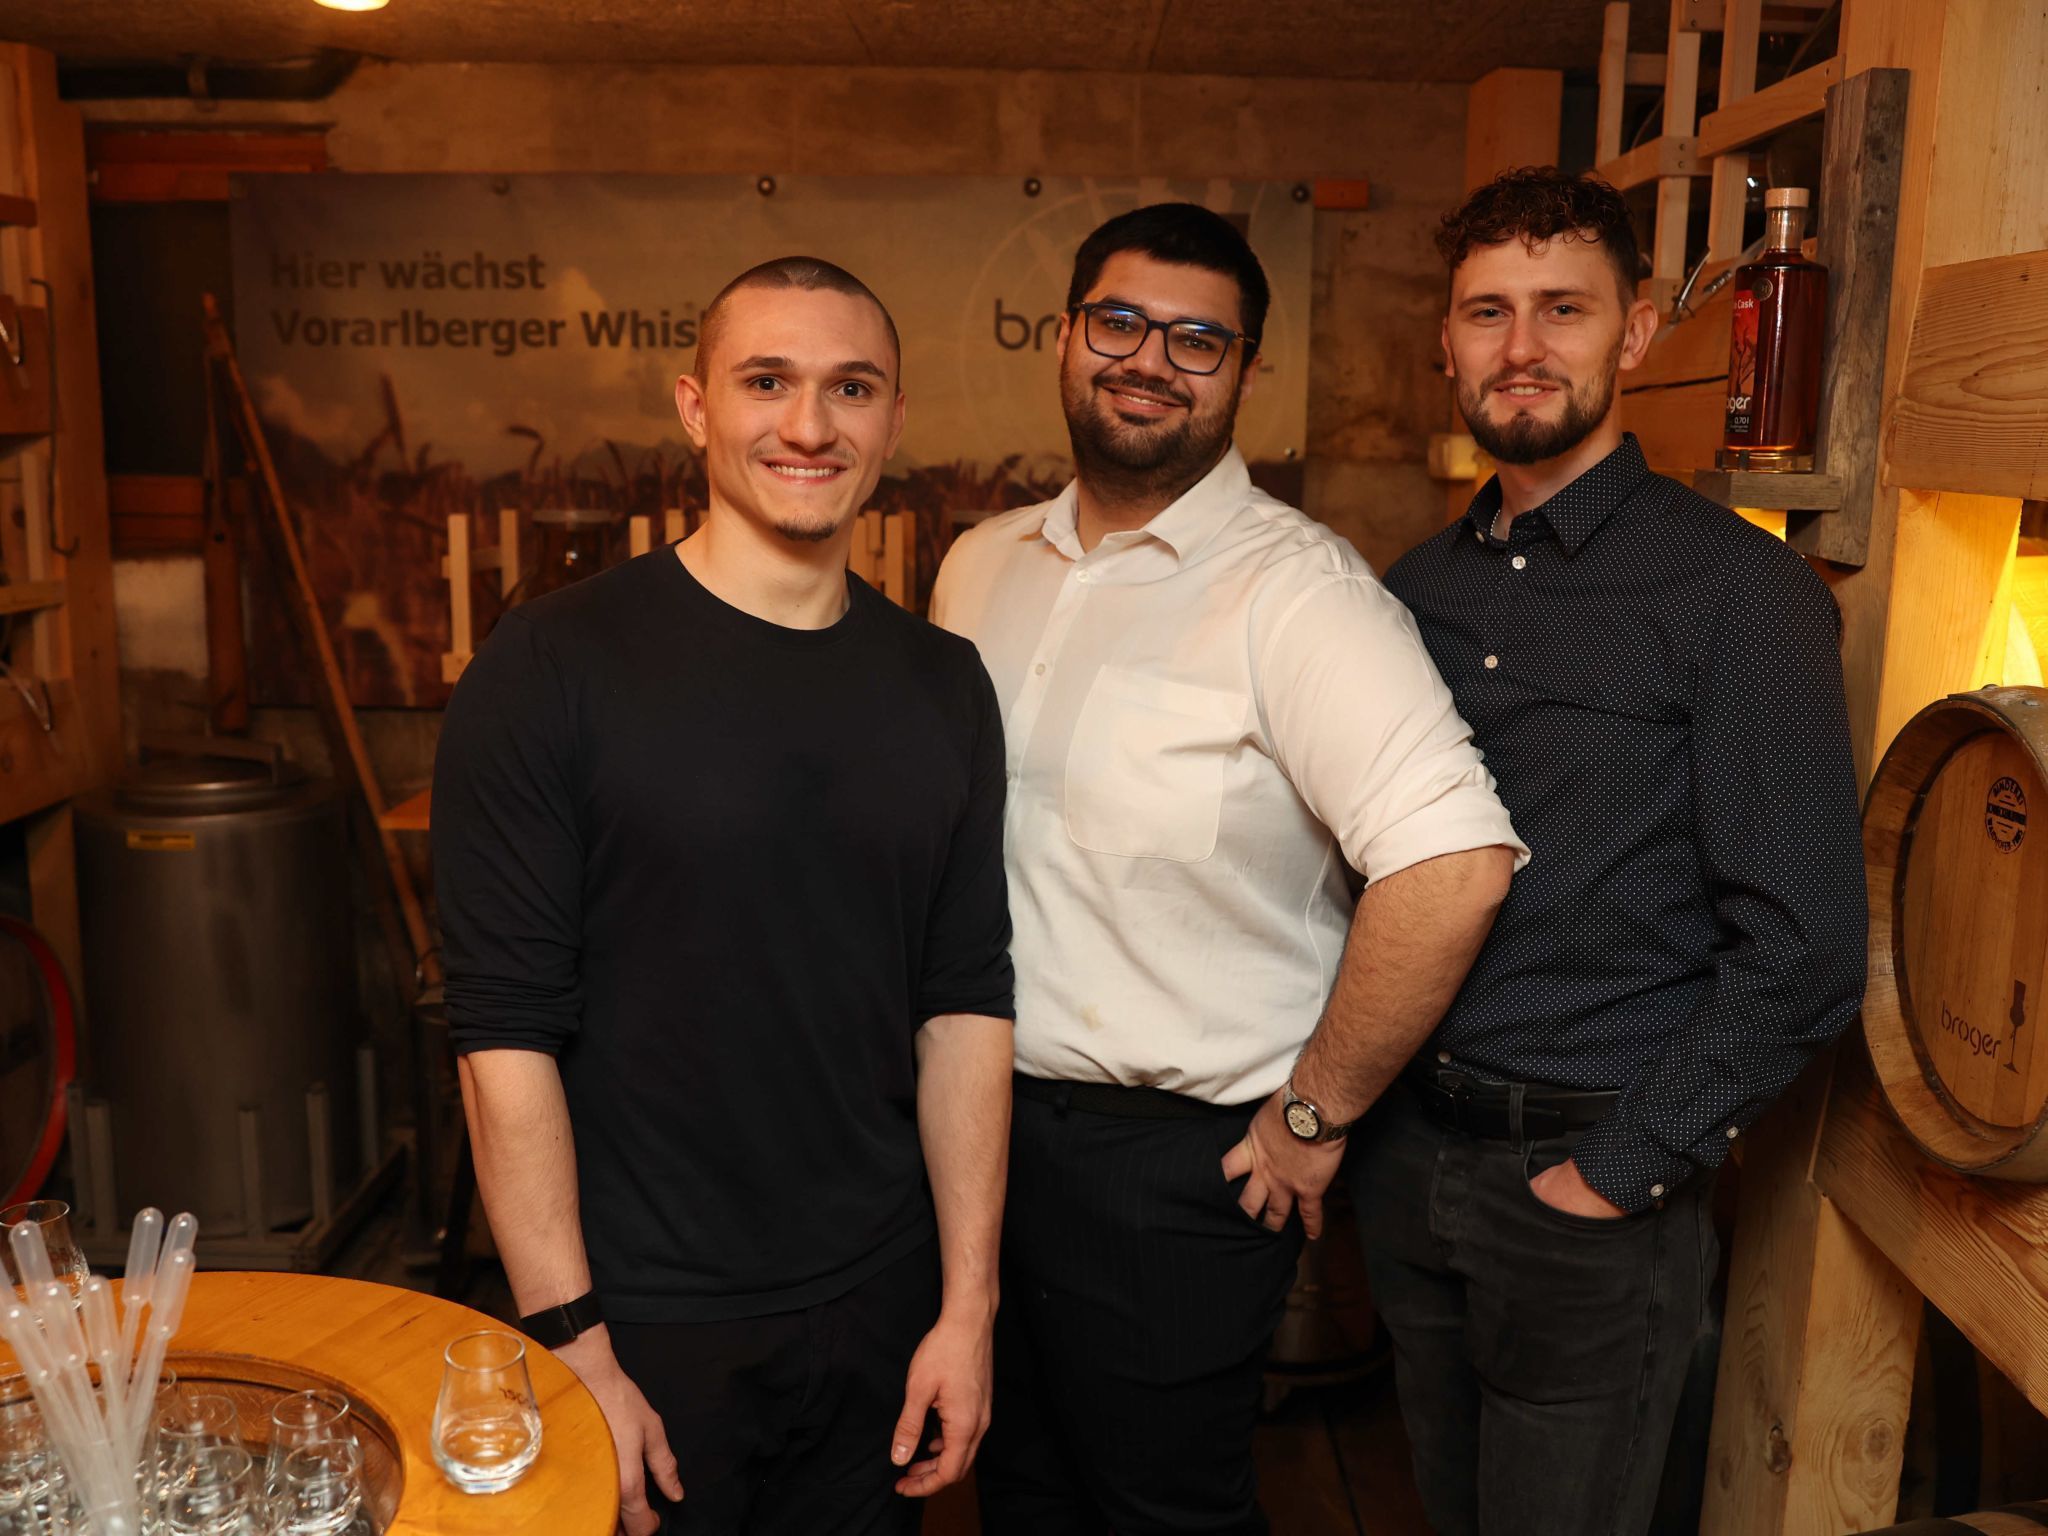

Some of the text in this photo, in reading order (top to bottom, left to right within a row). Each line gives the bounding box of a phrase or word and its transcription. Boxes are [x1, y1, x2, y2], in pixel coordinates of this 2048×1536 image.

[272, 251, 546, 291] Hier wächst
[1737, 299, 1754, 309] Cask
[271, 309, 708, 357] Vorarlberger Whis
[1941, 999, 2002, 1059] broger
